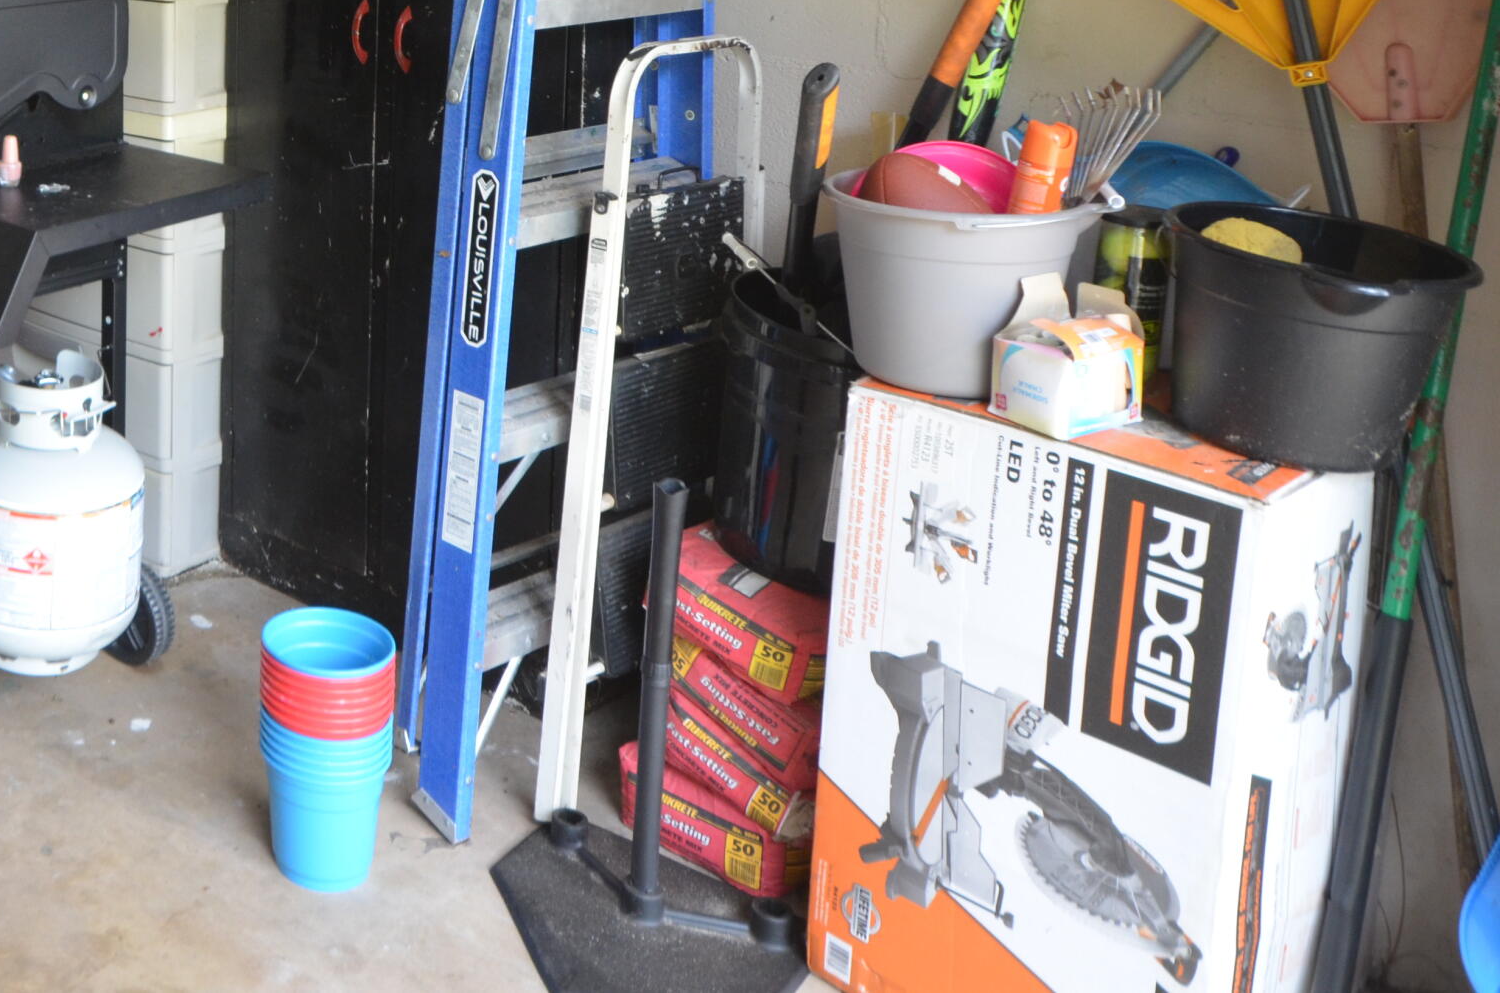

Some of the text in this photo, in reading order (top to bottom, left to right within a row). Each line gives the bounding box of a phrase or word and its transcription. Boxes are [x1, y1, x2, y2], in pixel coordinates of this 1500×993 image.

[465, 203, 491, 342] LOUISVILLE
[995, 435, 1004, 473] Cut-Line
[1006, 439, 1024, 484] LED
[1033, 446, 1041, 464] Left
[990, 475, 1000, 521] Indication
[1027, 485, 1037, 510] Right
[1041, 479, 1057, 503] to
[1038, 509, 1055, 546] 48°
[983, 541, 993, 586] Worklight
[1055, 467, 1087, 658] 12 in. Dual Bevel Miter Saw
[676, 598, 743, 650] st-Setting
[696, 593, 748, 631] QUIKRETE
[1132, 506, 1211, 745] RIDGID
[761, 645, 786, 663] 50
[700, 676, 780, 746] Fast-Setting
[666, 721, 739, 791] Fast-Setting
[682, 717, 732, 760] QUIKRETE
[661, 793, 699, 820] IKRETE
[757, 791, 781, 815] 50
[660, 813, 711, 847] -Setting
[731, 838, 755, 857] 50
[856, 888, 870, 940] LIFETIME
